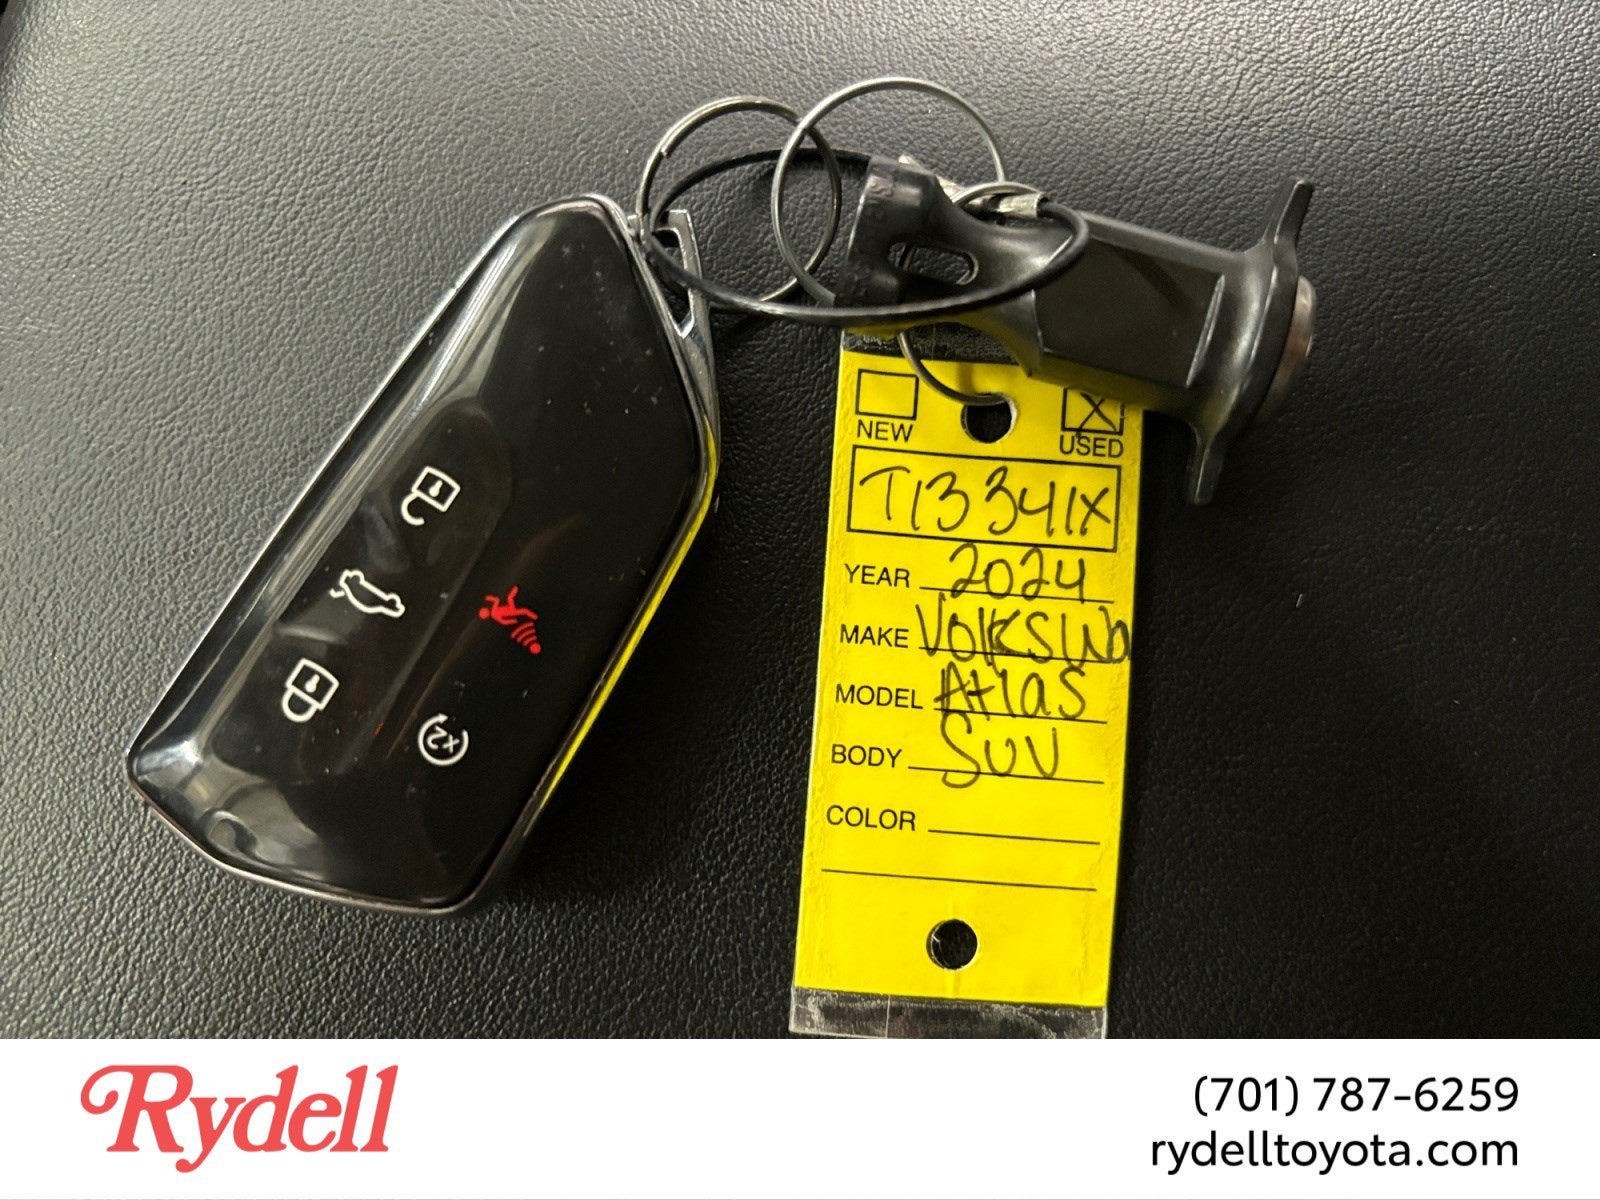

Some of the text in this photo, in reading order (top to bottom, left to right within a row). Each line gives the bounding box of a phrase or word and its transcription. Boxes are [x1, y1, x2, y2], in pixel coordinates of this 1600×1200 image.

[857, 420, 913, 442] NEW
[1059, 434, 1124, 458] USED
[845, 563, 910, 588] YEAR
[949, 542, 1086, 604] 2024
[840, 624, 909, 649] MAKE
[835, 684, 923, 710] MODEL
[831, 743, 902, 769] BODY
[826, 804, 917, 831] COLOR
